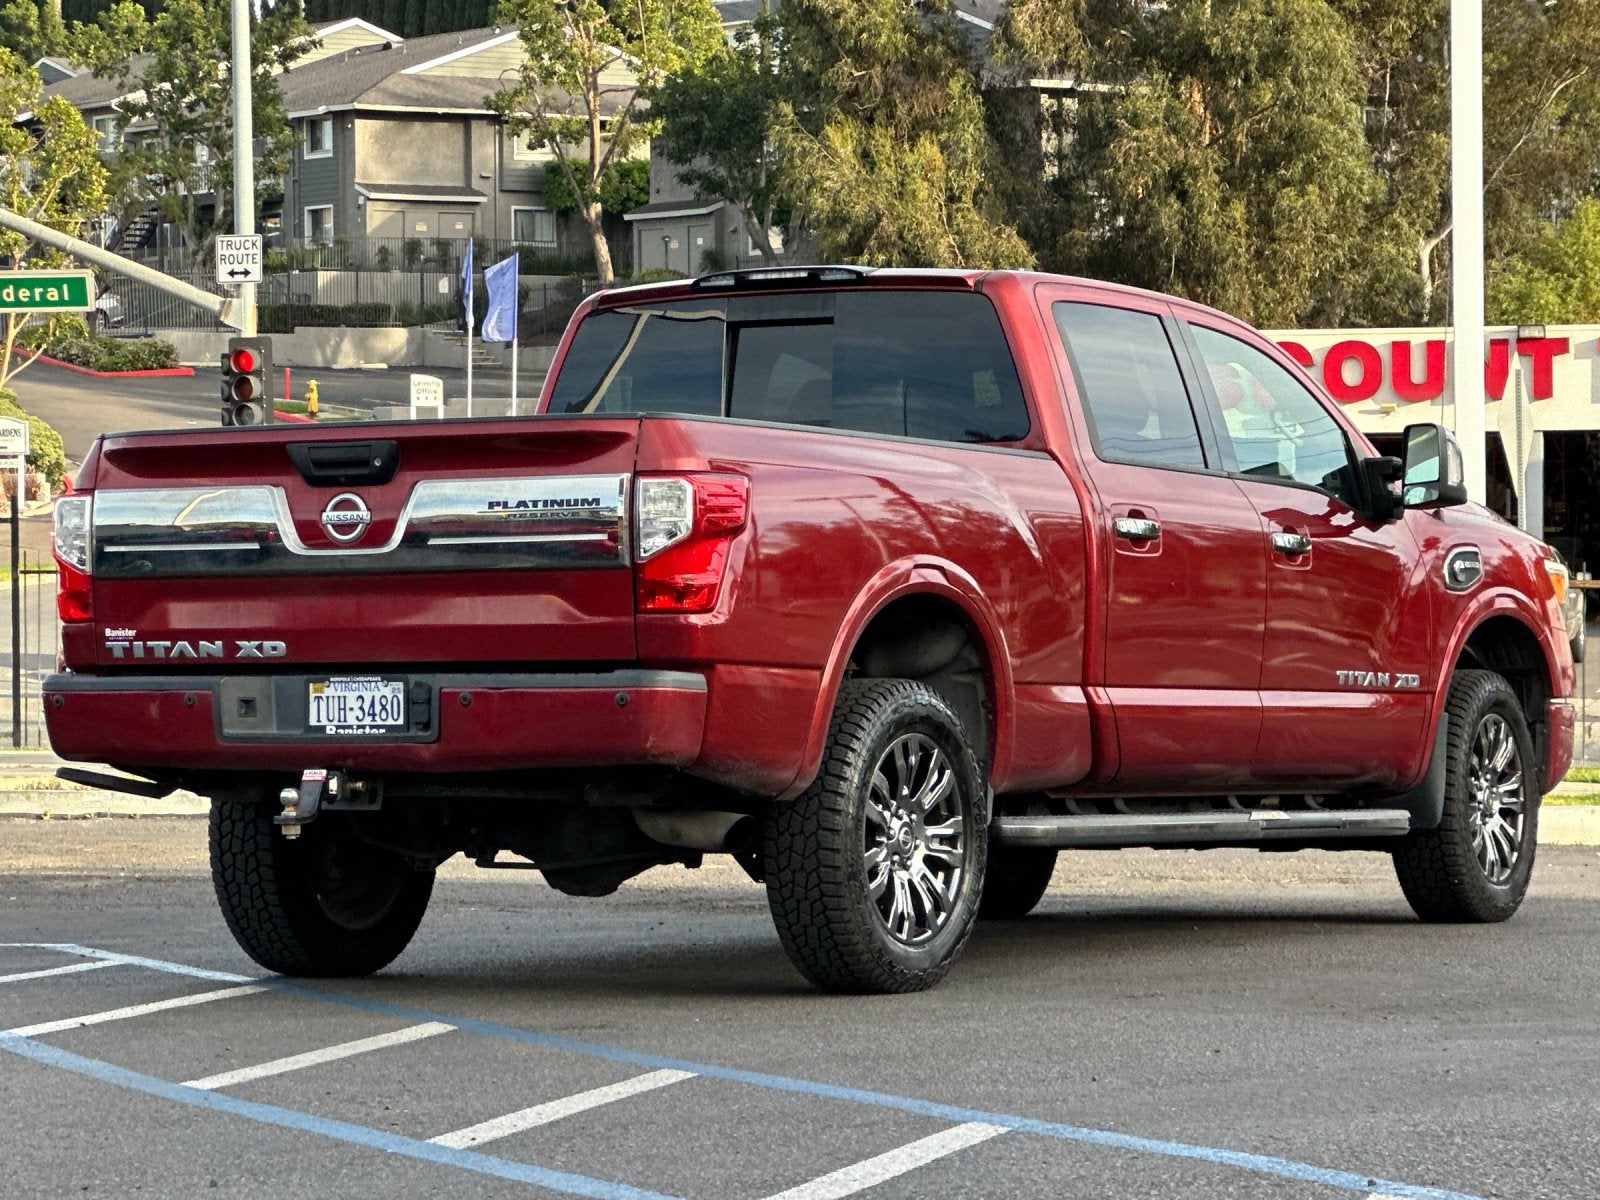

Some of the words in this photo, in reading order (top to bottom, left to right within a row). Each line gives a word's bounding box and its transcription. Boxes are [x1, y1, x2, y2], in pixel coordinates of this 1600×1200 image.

[219, 239, 259, 250] TRUCK
[219, 253, 259, 265] ROUTE
[2, 283, 69, 302] deral
[1277, 337, 1570, 402] OUT
[413, 380, 441, 388] Leasing
[488, 497, 601, 510] PLATINUM
[325, 513, 365, 522] NISSAN
[506, 511, 581, 519] RESERVE
[105, 627, 137, 637] Banister
[105, 641, 224, 658] TITAN
[235, 641, 287, 658] XD
[1336, 670, 1390, 687] TITAN
[1394, 674, 1420, 688] XD
[333, 681, 380, 692] VIRGINIA
[313, 695, 401, 723] TUH-3480
